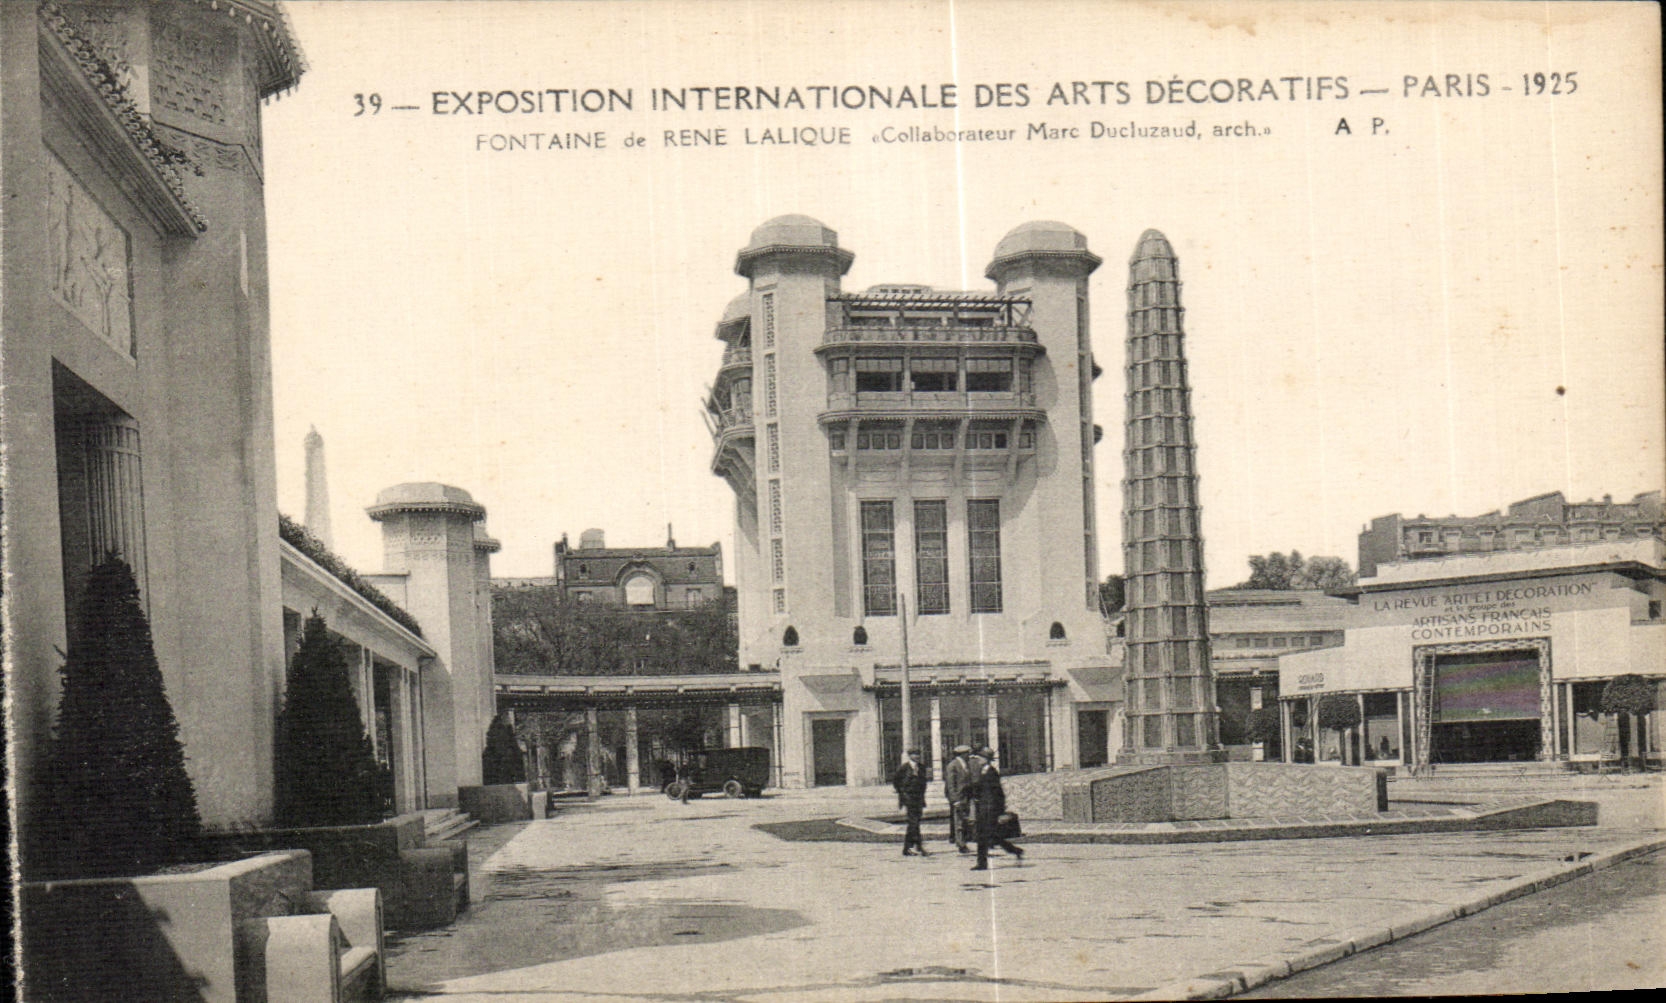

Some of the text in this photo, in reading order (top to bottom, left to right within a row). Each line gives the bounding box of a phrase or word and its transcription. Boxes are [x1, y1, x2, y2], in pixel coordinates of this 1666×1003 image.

[1374, 600, 1391, 612] LA
[1394, 596, 1438, 610] REVUE
[1412, 613, 1476, 629] ARTISANS
[1411, 620, 1552, 641] CONTEMPORAINS
